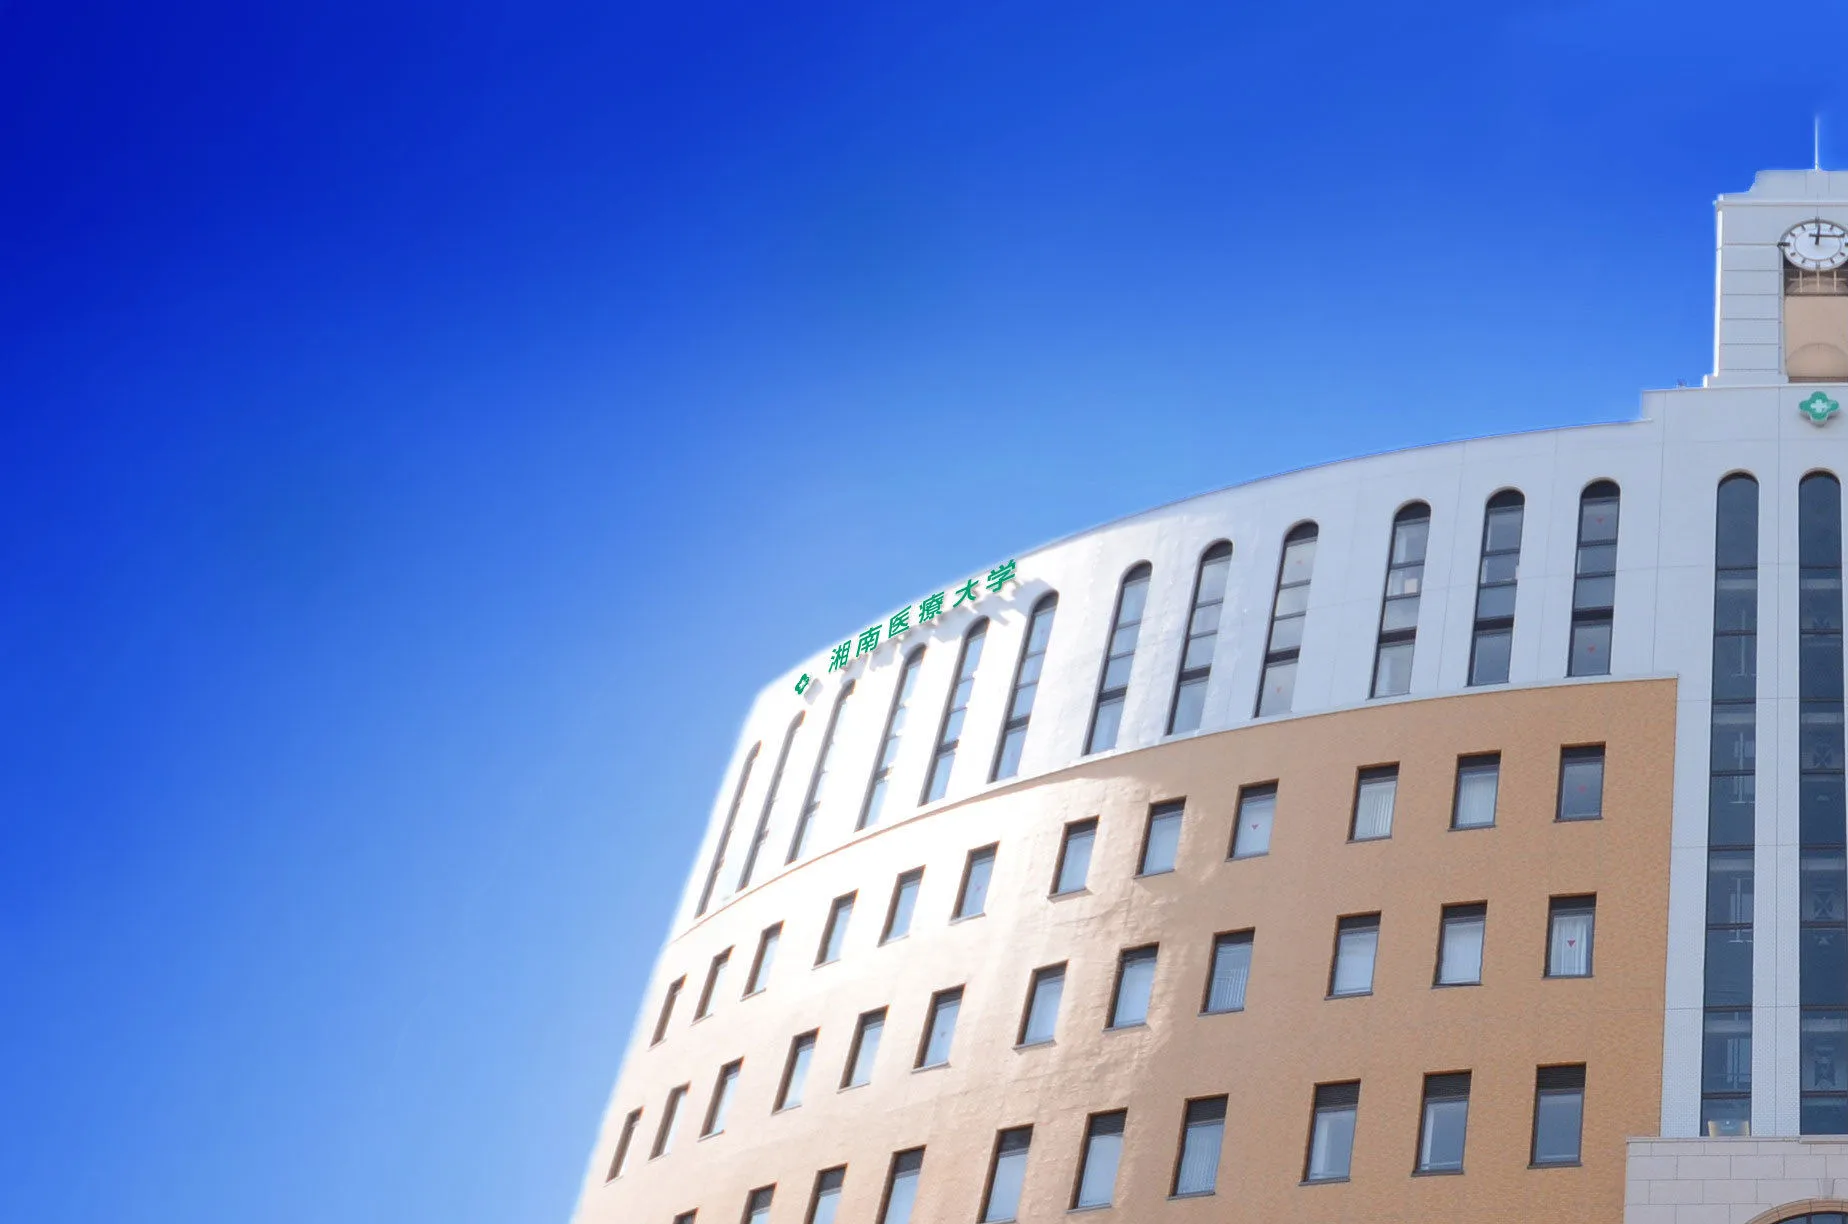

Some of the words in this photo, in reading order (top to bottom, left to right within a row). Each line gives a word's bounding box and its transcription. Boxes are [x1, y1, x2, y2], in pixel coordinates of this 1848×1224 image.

[828, 558, 1016, 673] 湘南医療大学
